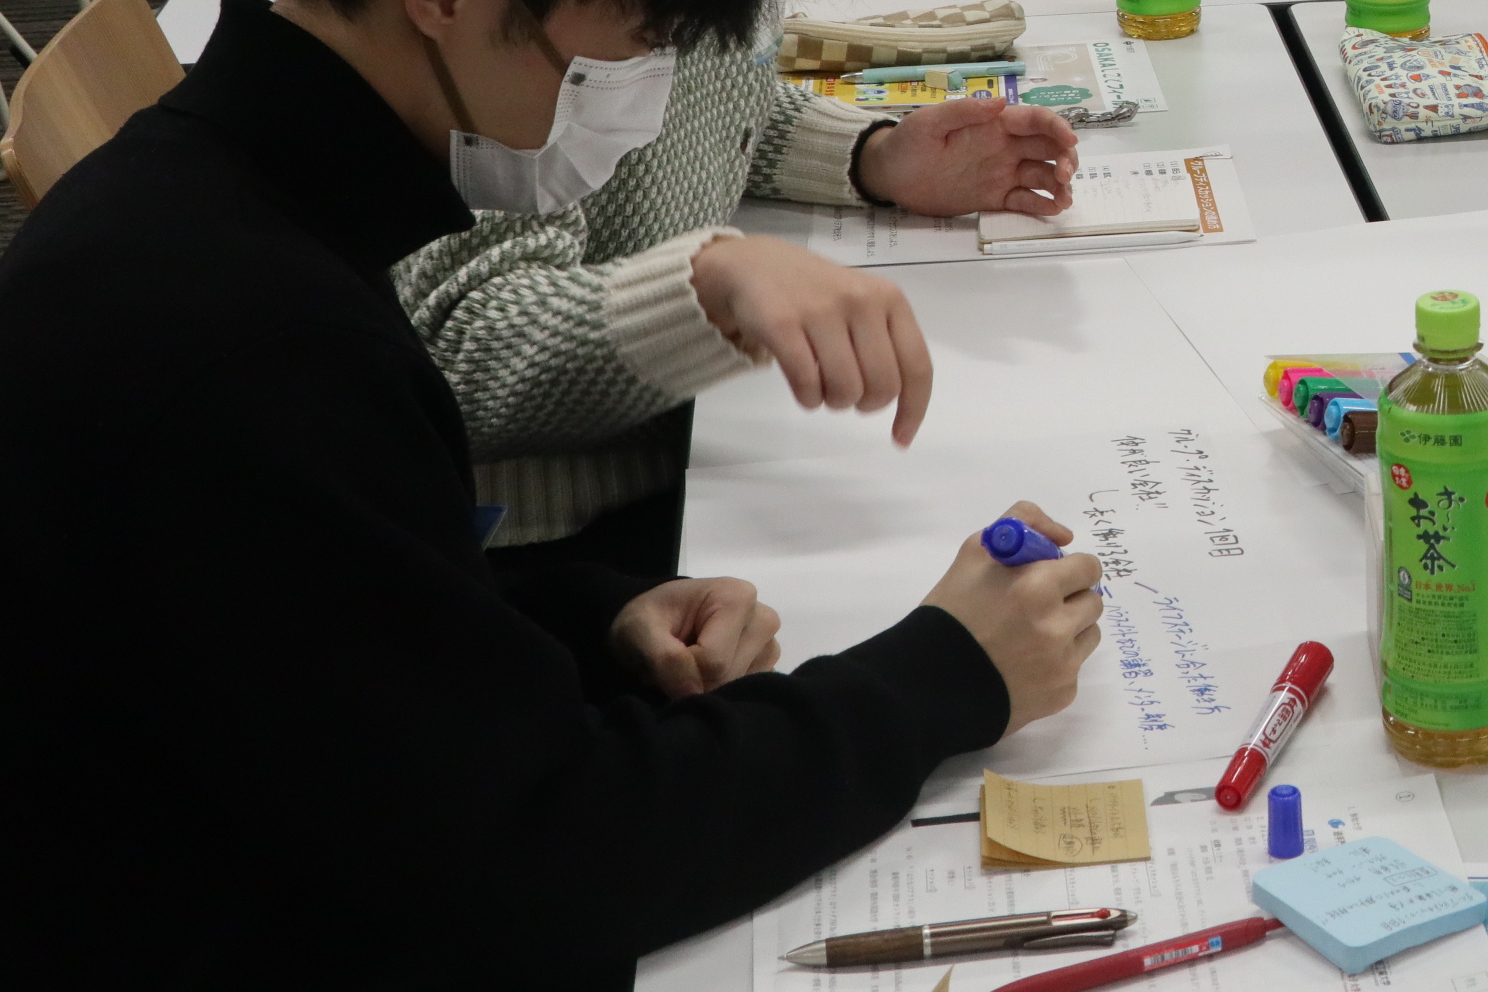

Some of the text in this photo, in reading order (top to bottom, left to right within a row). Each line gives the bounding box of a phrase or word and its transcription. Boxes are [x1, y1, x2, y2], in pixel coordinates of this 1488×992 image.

[1092, 41, 1132, 108] OSAKAしごとフィール
[1417, 432, 1463, 447] 伊藤園
[1408, 492, 1457, 576] お茶
